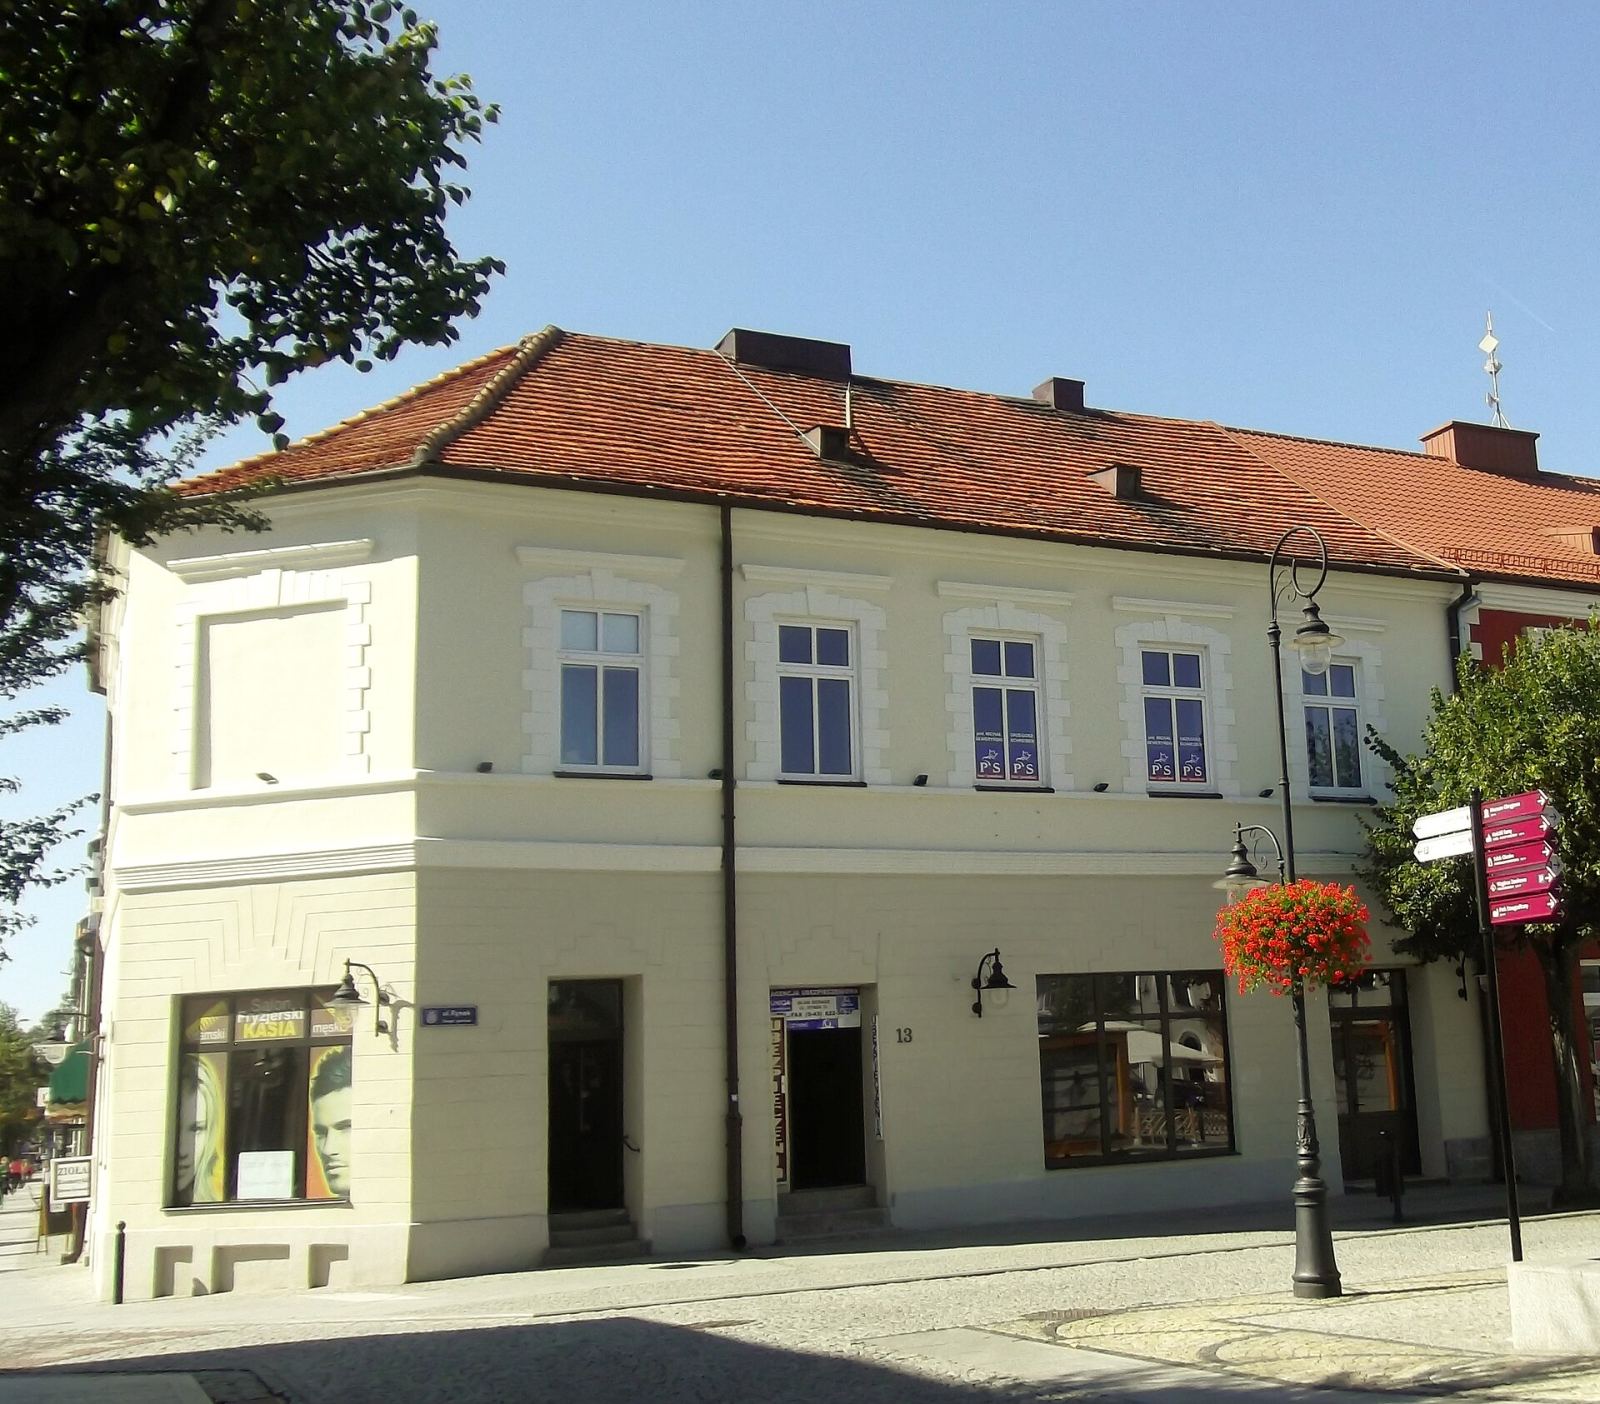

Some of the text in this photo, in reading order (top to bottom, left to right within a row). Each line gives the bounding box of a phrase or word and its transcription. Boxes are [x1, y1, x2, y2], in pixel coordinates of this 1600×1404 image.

[237, 1008, 304, 1025] Fryzjerski
[243, 1020, 296, 1039] KASIA
[895, 1027, 913, 1043] 13
